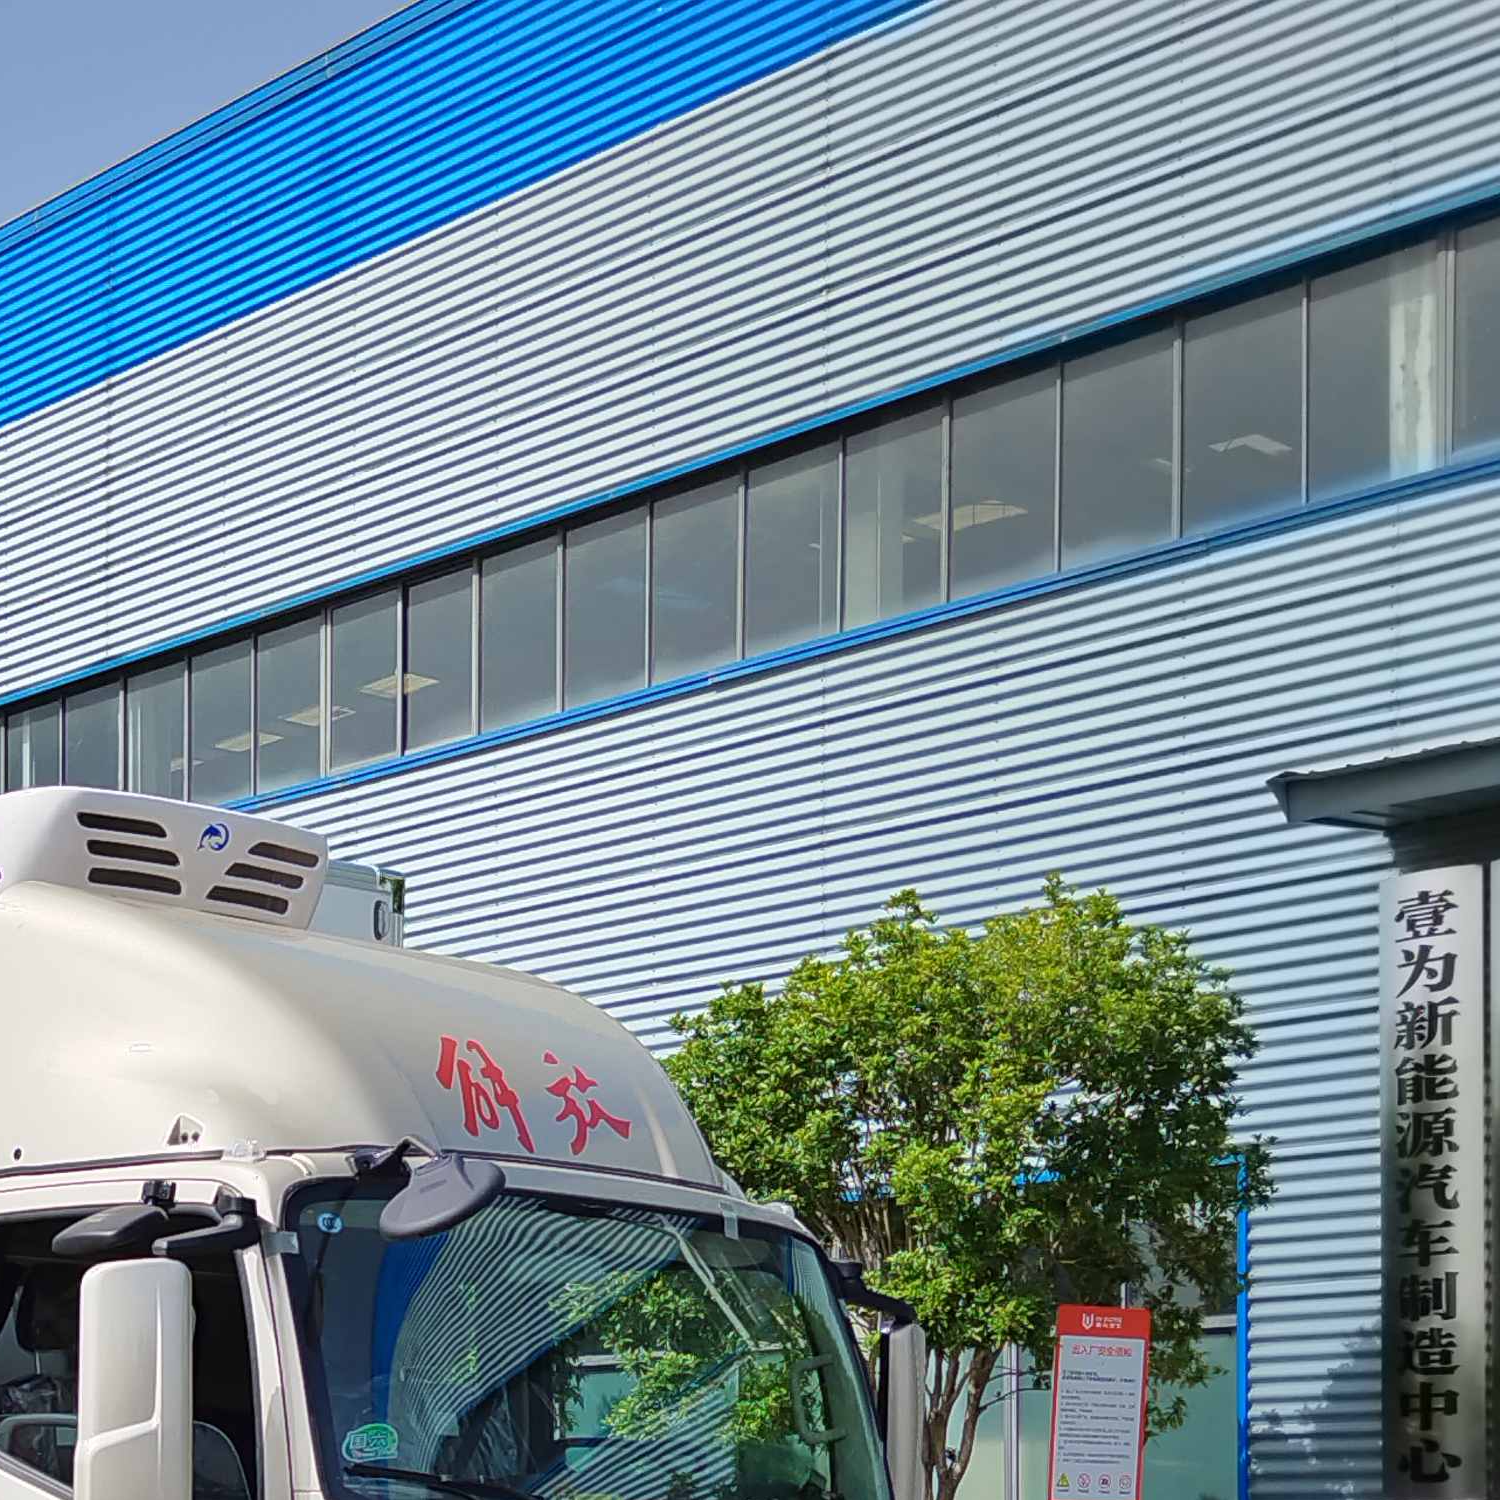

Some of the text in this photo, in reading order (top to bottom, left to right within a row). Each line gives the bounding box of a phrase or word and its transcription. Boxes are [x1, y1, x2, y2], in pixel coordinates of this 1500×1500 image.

[1394, 889, 1462, 1484] 壹为新能源汽车制造中心
[349, 1431, 388, 1450] 国六
